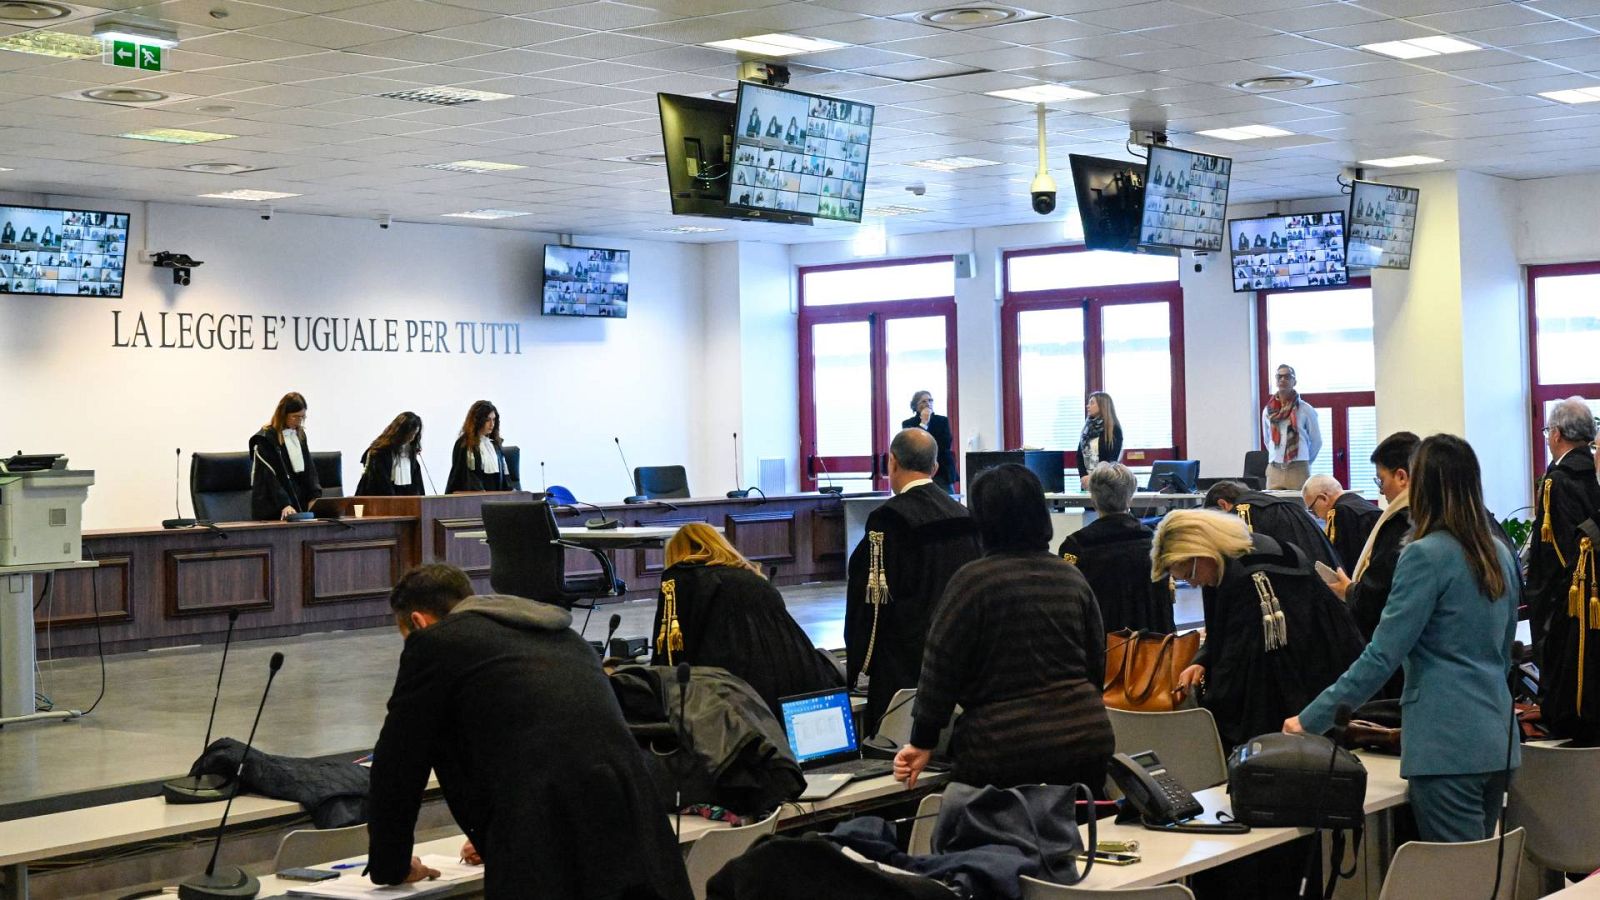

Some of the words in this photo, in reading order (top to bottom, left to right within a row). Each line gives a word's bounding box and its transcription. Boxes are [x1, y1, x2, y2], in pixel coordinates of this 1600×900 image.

[112, 311, 152, 348] LA
[159, 312, 254, 350] LEGGE
[292, 316, 399, 352] UGUALE
[405, 319, 450, 353] PER
[455, 321, 521, 355] TUTTI
